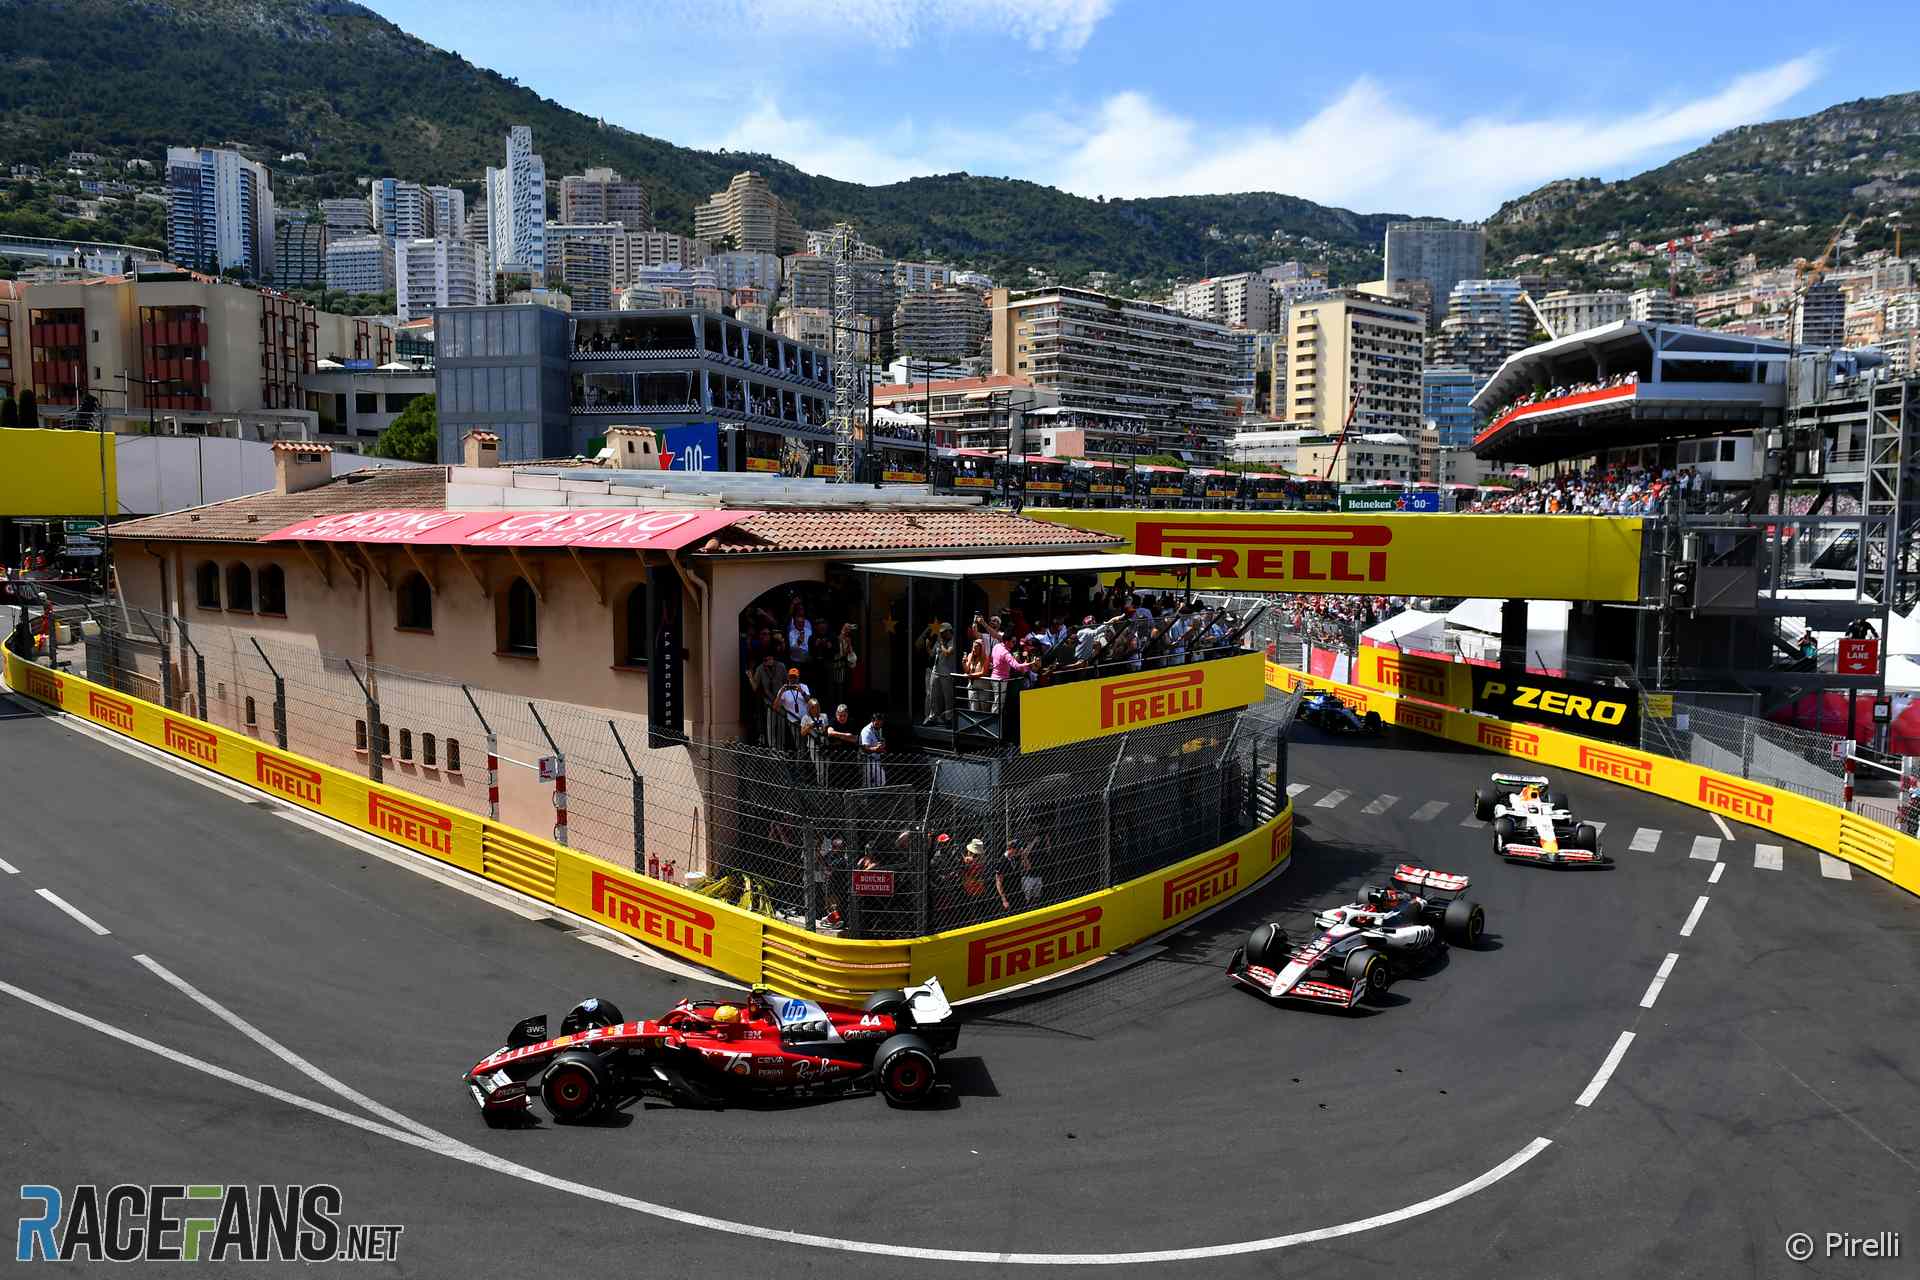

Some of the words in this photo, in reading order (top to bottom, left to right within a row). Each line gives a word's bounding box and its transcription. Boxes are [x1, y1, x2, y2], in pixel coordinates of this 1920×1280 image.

[316, 512, 466, 530] CASINO
[499, 513, 695, 532] CASINO
[1349, 500, 1392, 509] Heineken
[1377, 656, 1445, 697] PIRELLI
[89, 691, 134, 731] PIRELLI
[1100, 670, 1204, 729] PIRELLI
[1481, 681, 1506, 700] P
[1513, 686, 1628, 726] ZERO
[164, 719, 217, 763] PIRELLI
[1477, 722, 1539, 757] PIRELLI
[256, 751, 321, 805] PIRELLI
[1579, 745, 1653, 786] PIRELLI
[1699, 776, 1773, 824] PIRELLI
[369, 791, 452, 855] PIRELLI
[1163, 852, 1239, 920] PIRELLI
[592, 871, 715, 958] PIRELLI
[968, 906, 1103, 987] PIRELLI
[526, 1025, 545, 1033] aws
[785, 1000, 805, 1021] hp
[860, 1014, 881, 1027] 44
[743, 1030, 762, 1040] IBM
